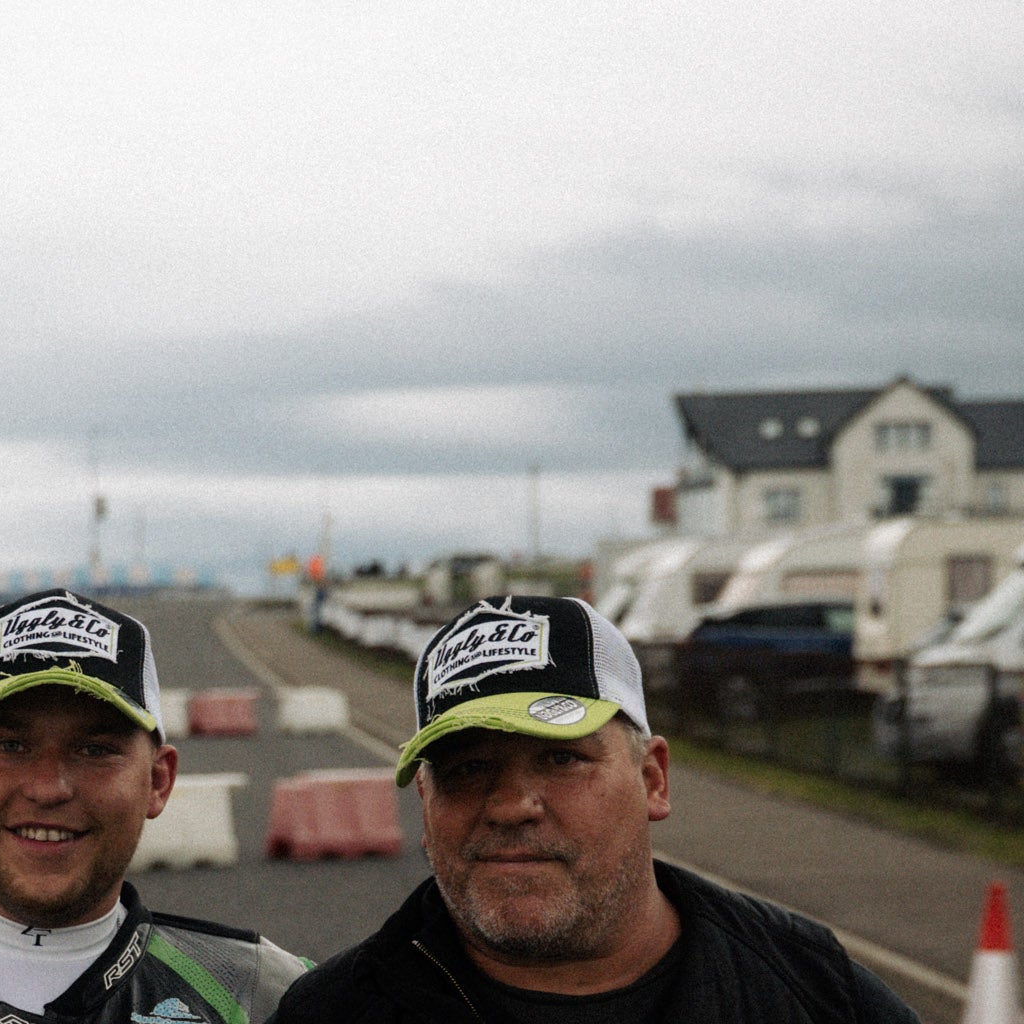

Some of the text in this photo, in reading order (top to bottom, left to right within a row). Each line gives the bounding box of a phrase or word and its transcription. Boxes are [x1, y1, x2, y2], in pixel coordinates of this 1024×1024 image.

[3, 631, 51, 648] CLOTHING
[63, 631, 109, 652] LIFESTYLE
[433, 655, 470, 684] CLOTHING
[482, 647, 537, 657] LIFESTYLE
[103, 931, 142, 990] RST
